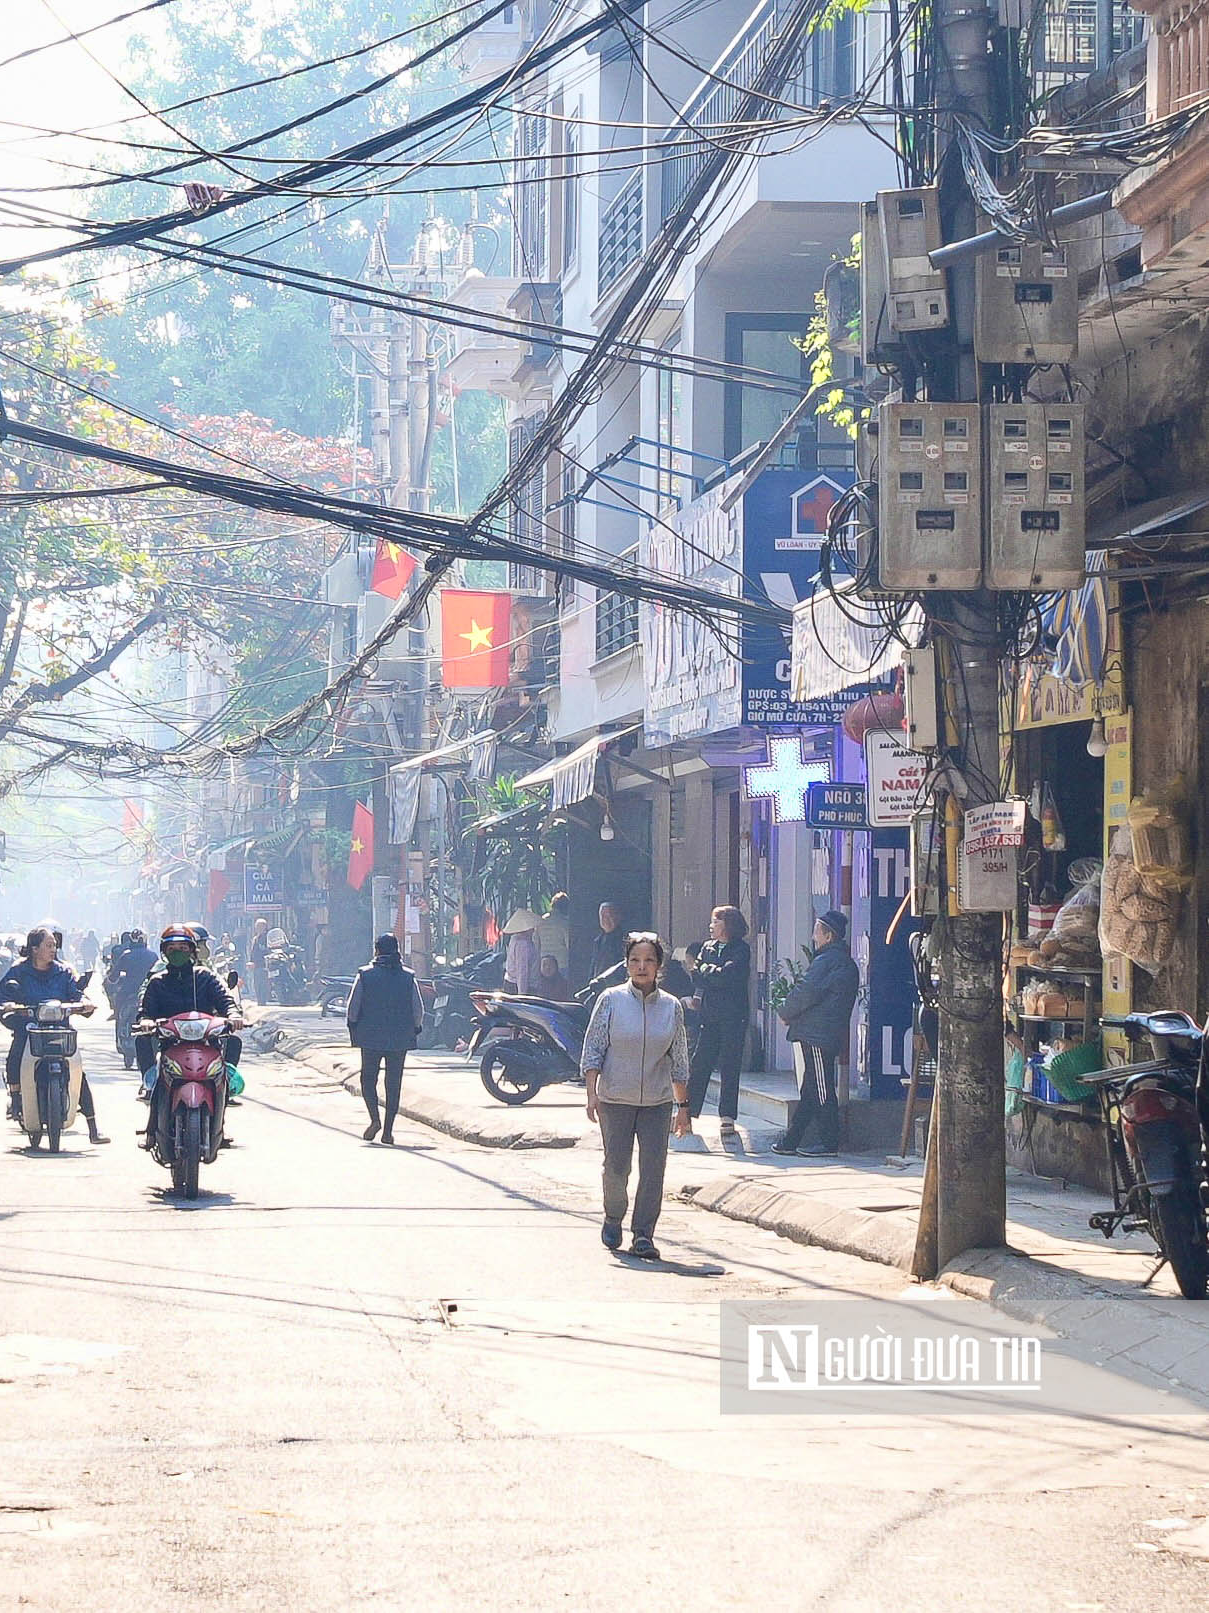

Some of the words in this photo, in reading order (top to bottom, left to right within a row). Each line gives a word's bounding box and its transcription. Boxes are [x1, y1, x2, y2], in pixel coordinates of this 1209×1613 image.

[748, 688, 777, 702] DƯỢC
[748, 710, 766, 722] GIỜ
[882, 779, 920, 792] NAM
[824, 787, 851, 805] NGÕ
[252, 872, 273, 880] CUA
[252, 894, 274, 903] MAU
